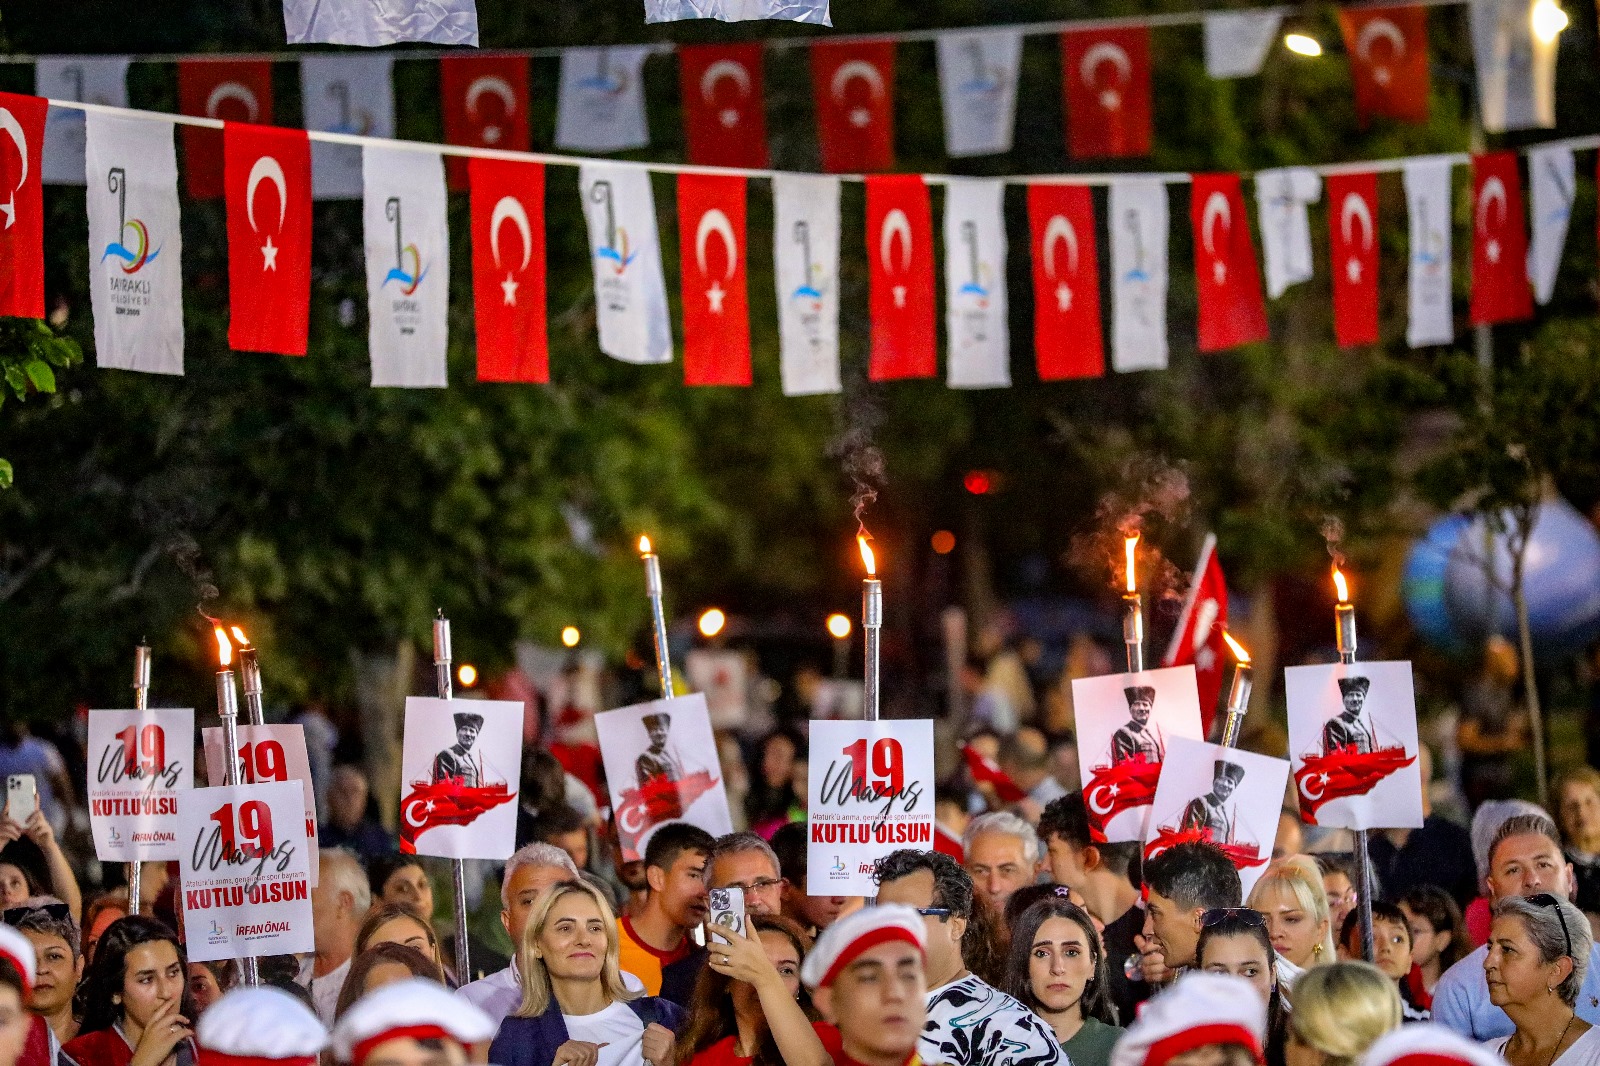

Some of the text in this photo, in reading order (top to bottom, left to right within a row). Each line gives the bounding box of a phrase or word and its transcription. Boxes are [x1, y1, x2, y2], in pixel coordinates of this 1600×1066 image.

[115, 724, 165, 775] 19
[238, 740, 288, 784] 19
[843, 738, 904, 797] 19
[92, 797, 177, 816] KUTLU OLSU
[820, 760, 923, 833] Mayıs
[152, 830, 176, 841] ÖNAL
[210, 800, 273, 860] 19
[812, 822, 930, 843] KUTLU OLSUN
[192, 827, 295, 894] Mayıs
[858, 861, 878, 874] İRF
[186, 880, 307, 910] KUTLU OLSUN
[236, 921, 291, 936] İRFAN ÖNAL
